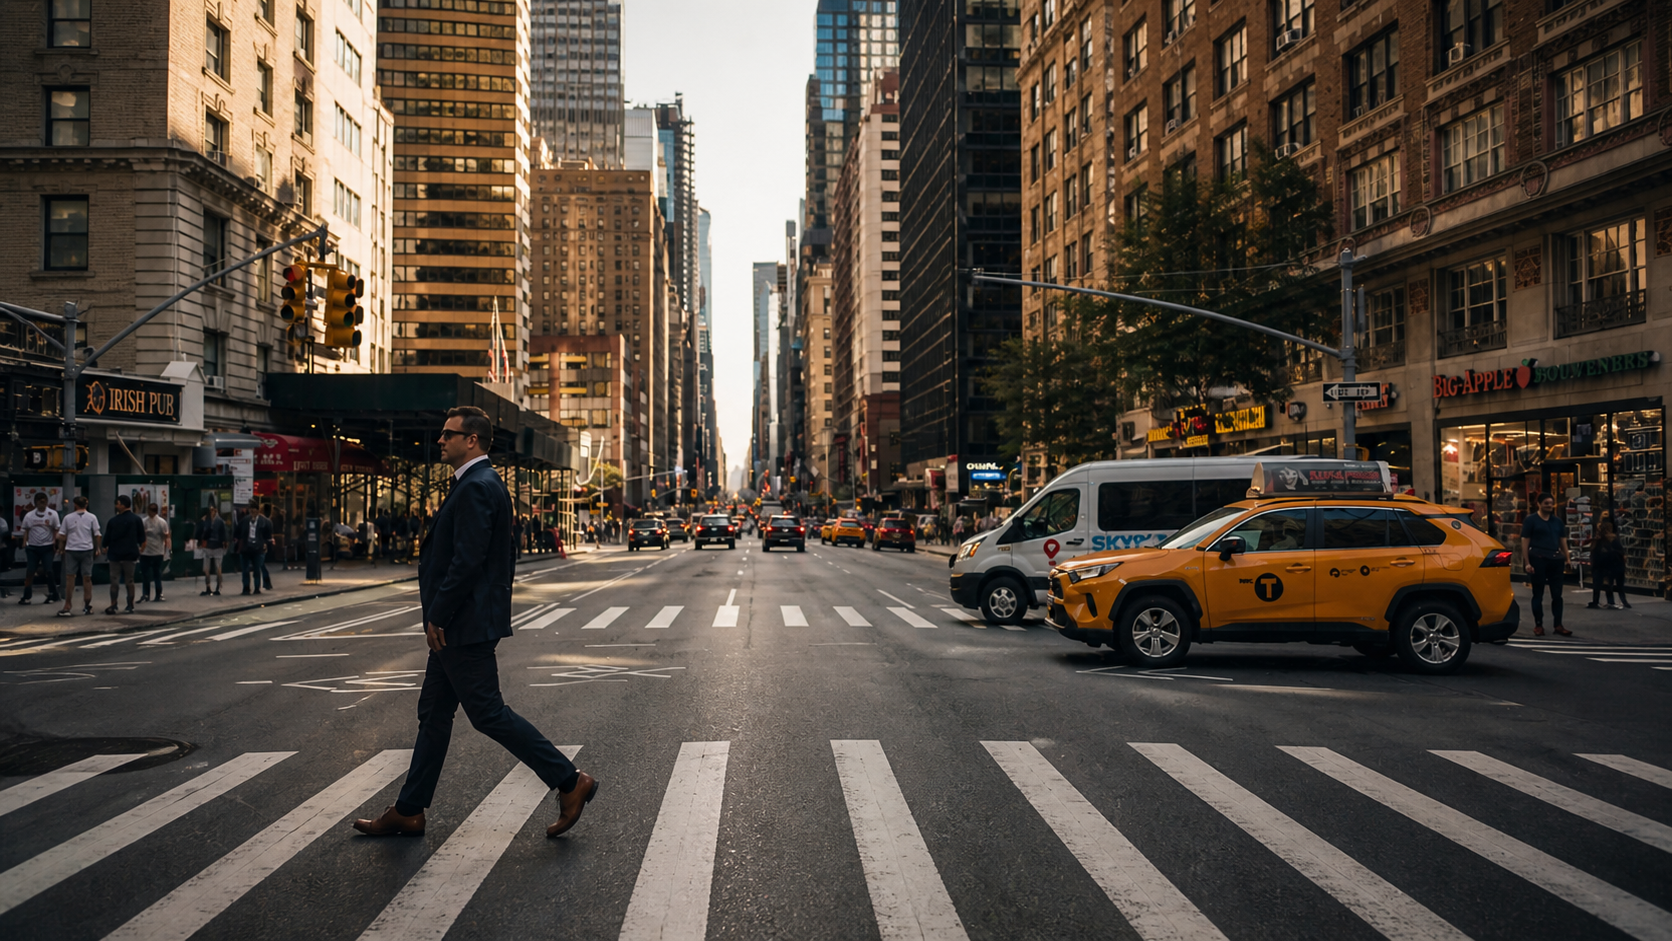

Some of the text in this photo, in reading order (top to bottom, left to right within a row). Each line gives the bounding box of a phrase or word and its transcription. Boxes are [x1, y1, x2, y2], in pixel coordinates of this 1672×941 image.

[109, 387, 174, 416] IRISH PUB
[1260, 577, 1277, 599] T
